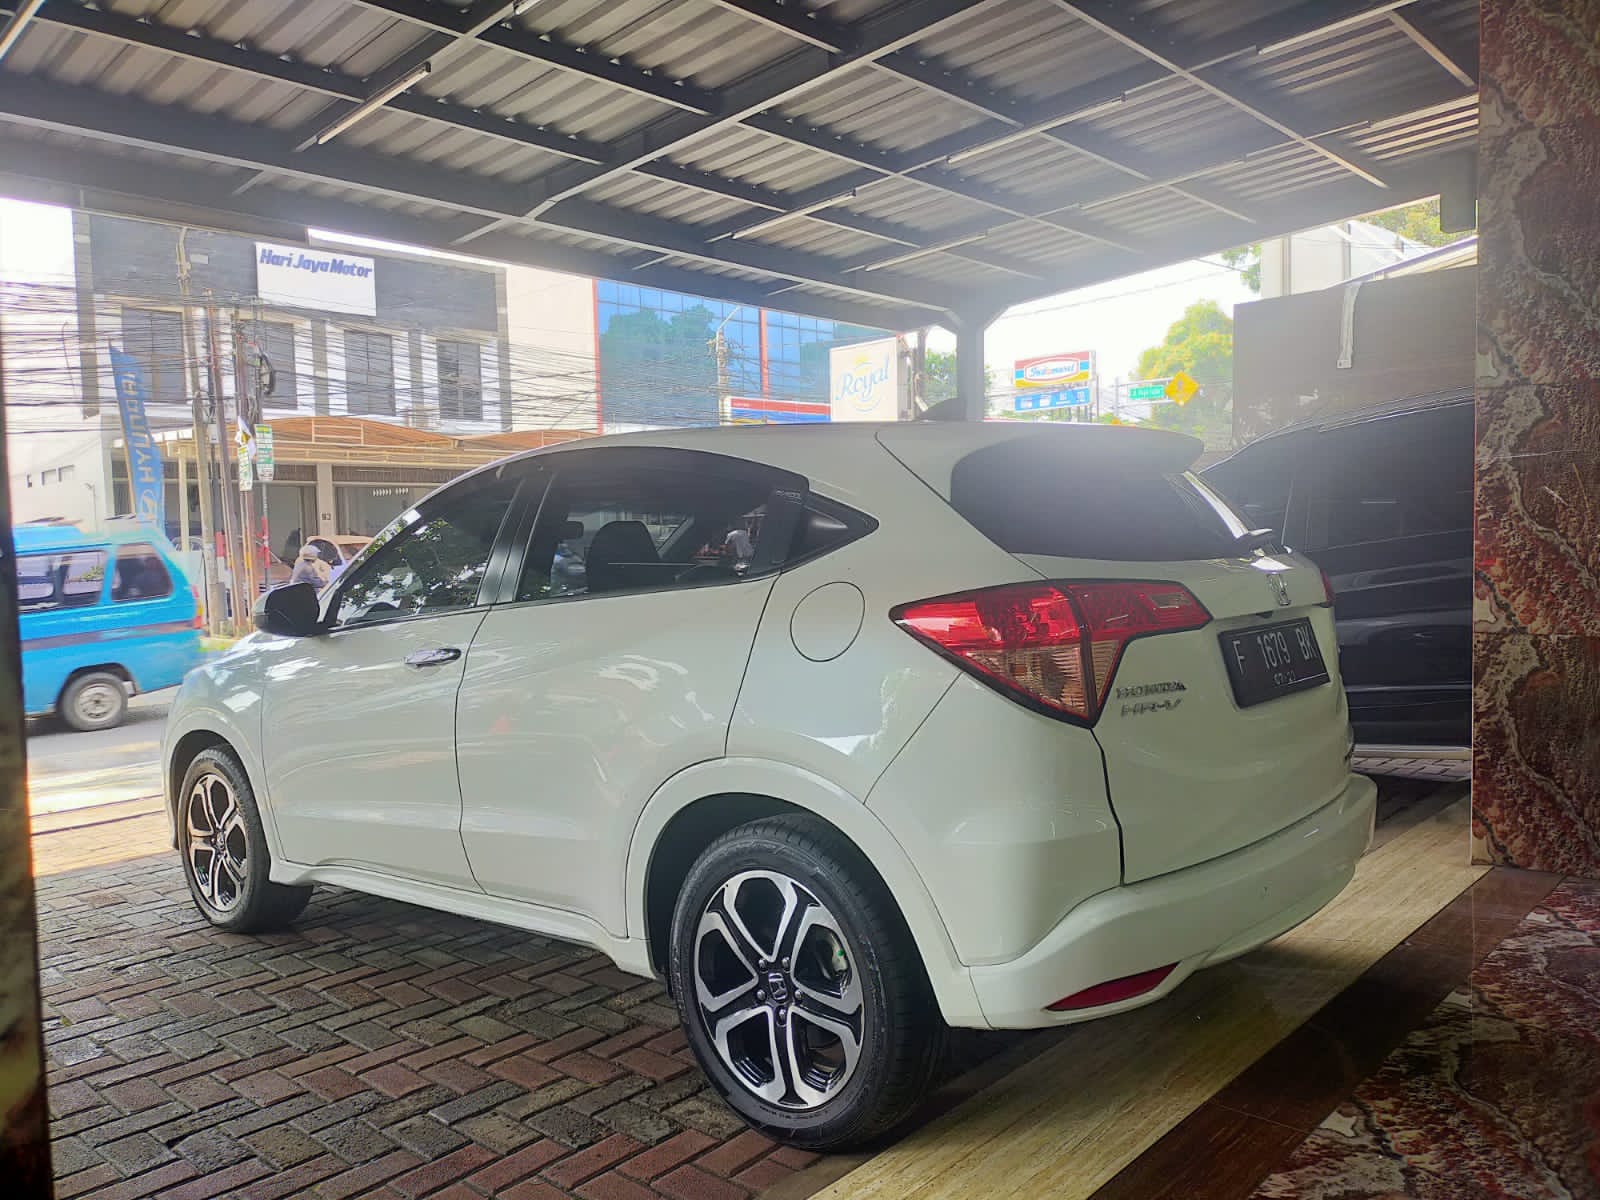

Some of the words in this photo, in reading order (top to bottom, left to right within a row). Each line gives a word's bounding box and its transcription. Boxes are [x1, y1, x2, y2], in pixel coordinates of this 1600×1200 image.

[260, 248, 293, 267] Hari
[293, 254, 330, 273] Jaya
[330, 258, 373, 278] Motor
[835, 352, 889, 401] Royal
[121, 371, 156, 484] HYUNDAI
[1232, 640, 1246, 675] F
[1257, 631, 1291, 670] 1679
